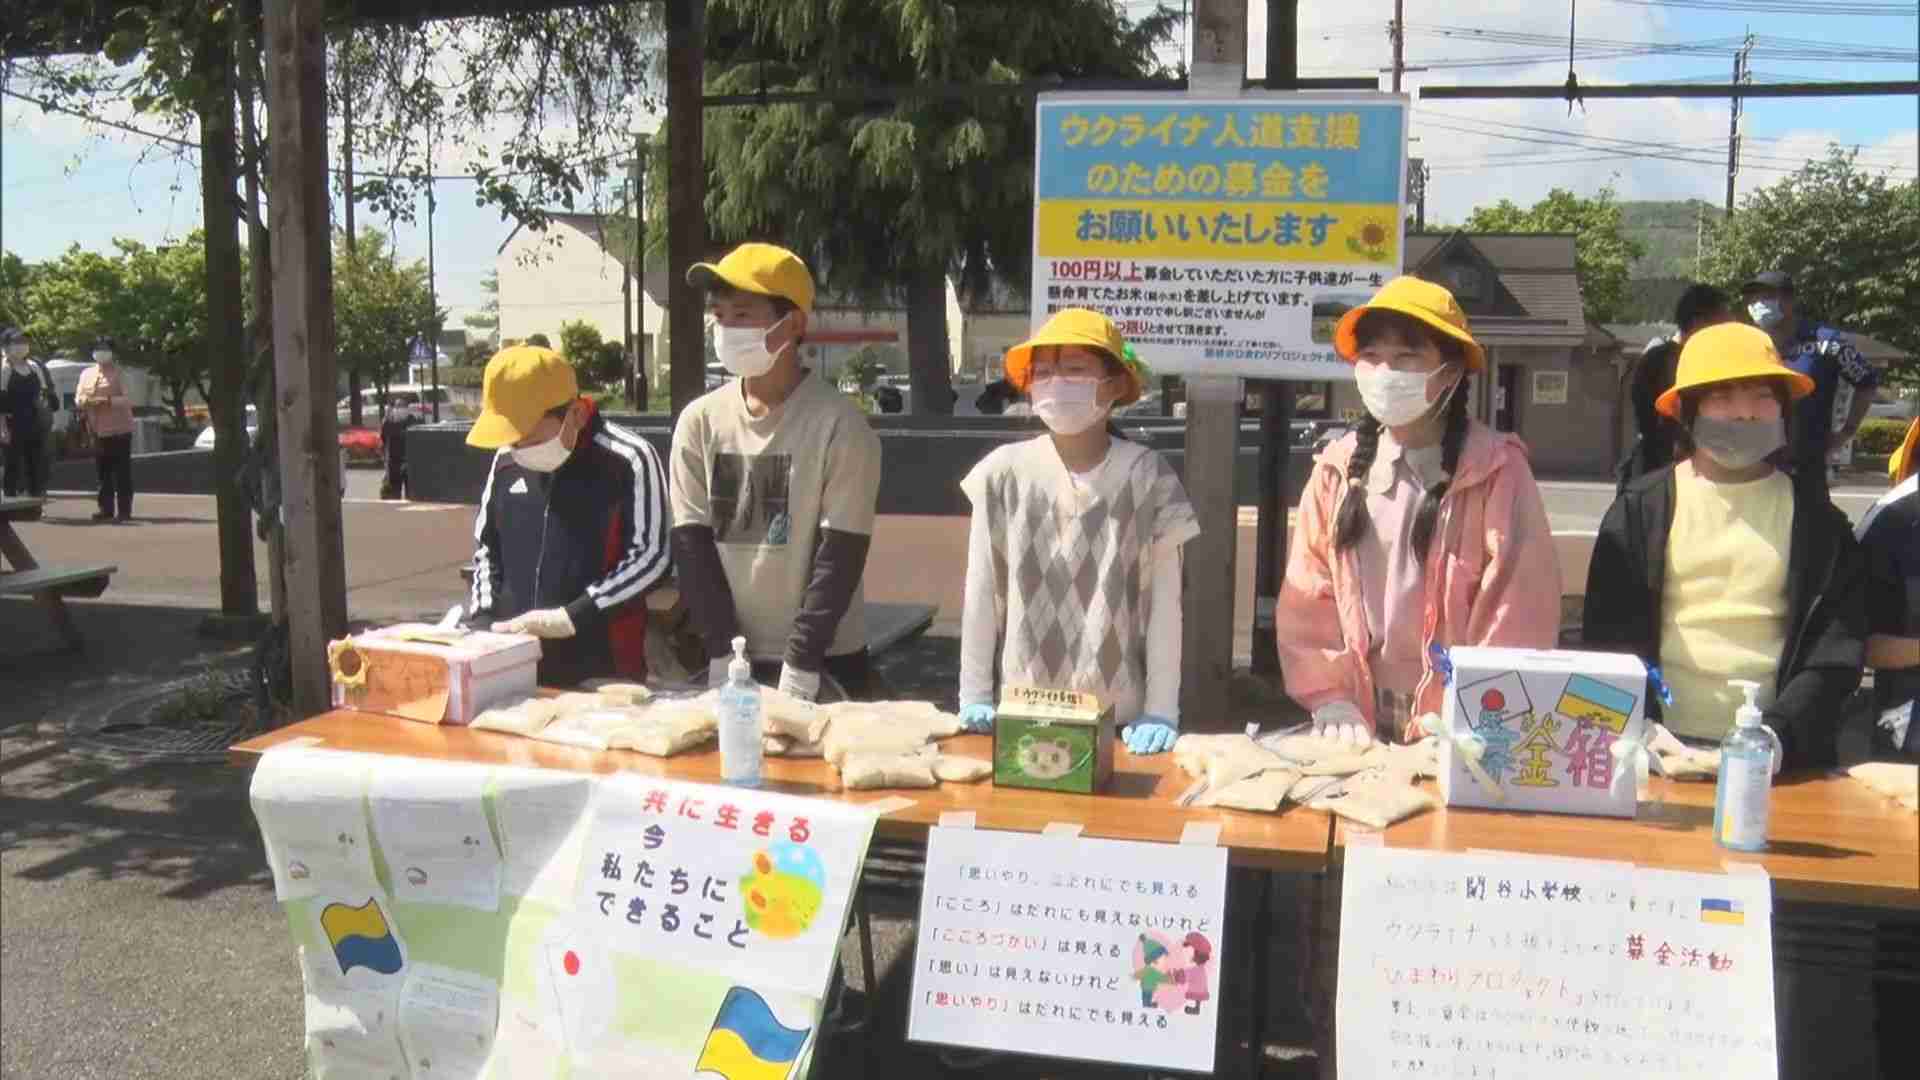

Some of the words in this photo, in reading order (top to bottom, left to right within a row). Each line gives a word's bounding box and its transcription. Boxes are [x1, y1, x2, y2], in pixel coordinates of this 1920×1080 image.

[1060, 111, 1361, 150] ウクライナ人道支援
[1087, 160, 1330, 199] のための募金を
[1075, 208, 1339, 248] お願いいたします
[642, 790, 811, 844] 共に生きる
[642, 823, 666, 850] 今
[600, 852, 728, 903] 私たちに
[596, 890, 750, 949] できること
[935, 895, 1211, 932] 「こころ」はだれにも見えないけれど
[928, 958, 1120, 990] 「思い」は見えないけれど
[925, 990, 1169, 1030] 「思いやり」はだれにでも見える
